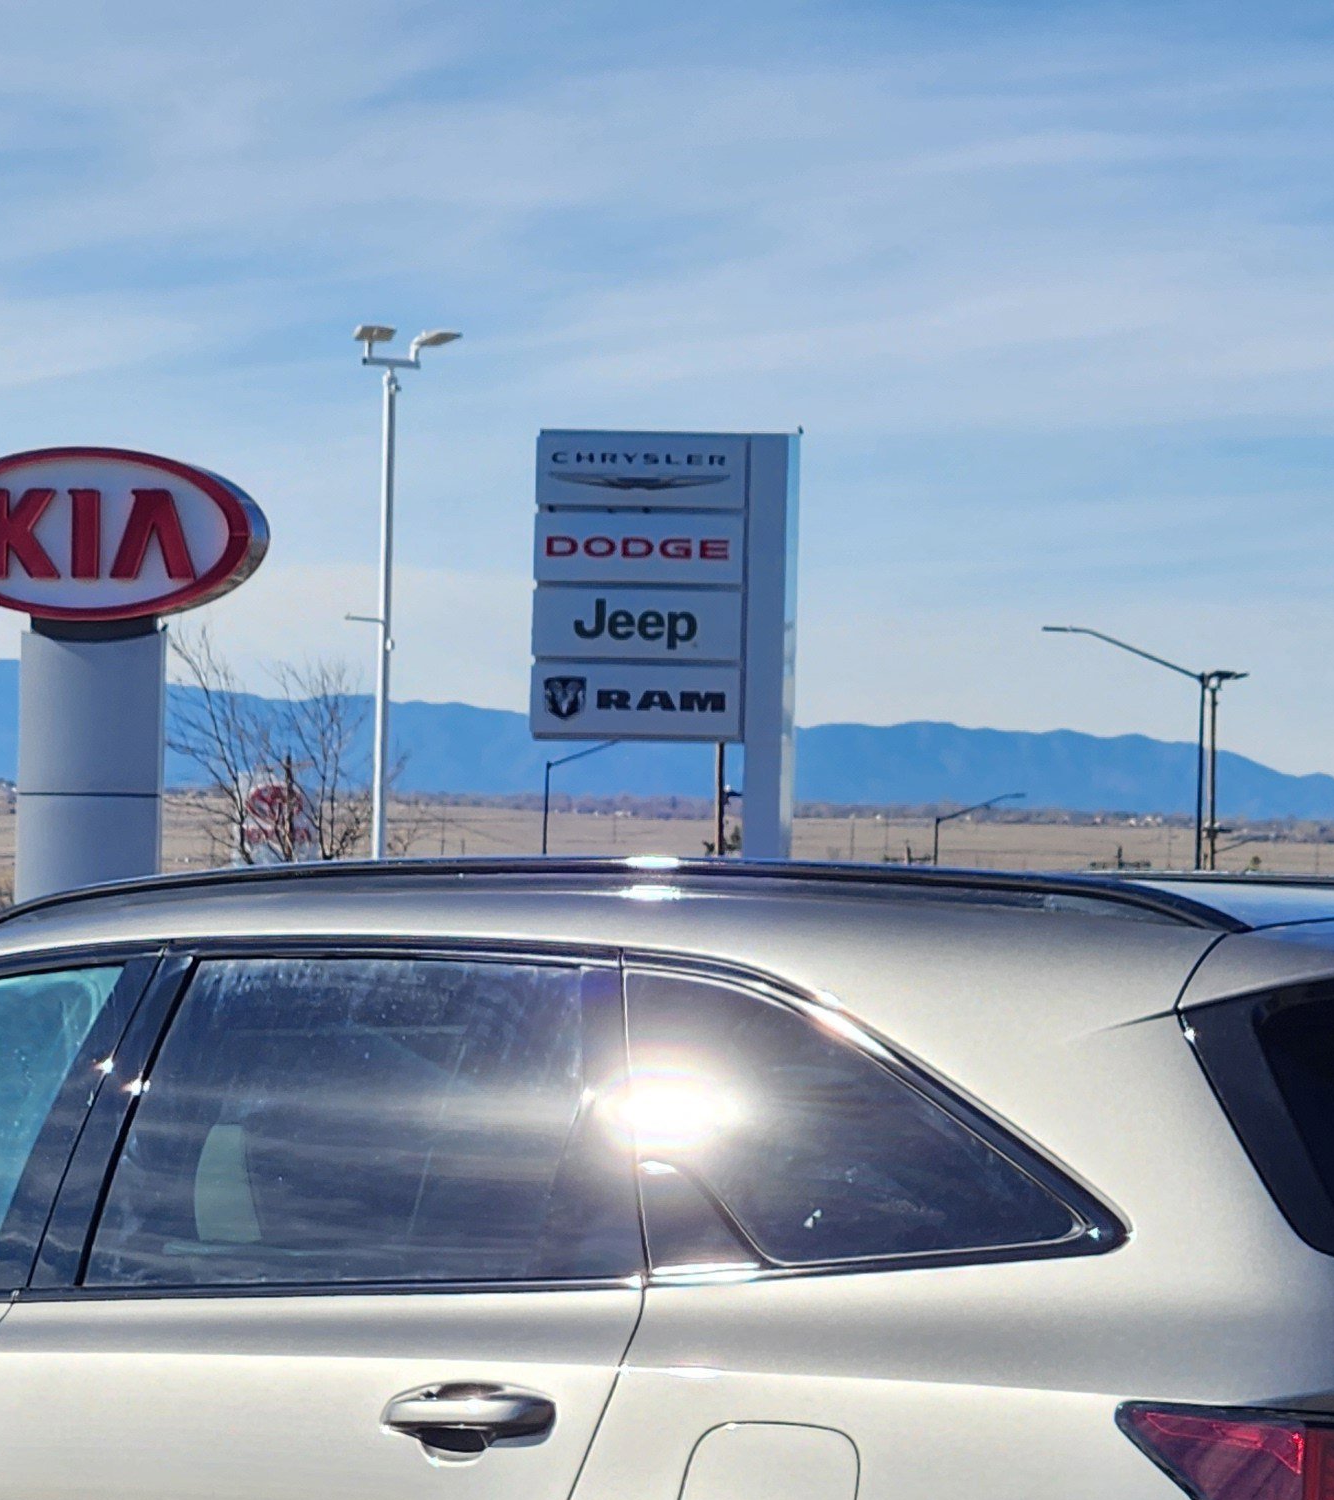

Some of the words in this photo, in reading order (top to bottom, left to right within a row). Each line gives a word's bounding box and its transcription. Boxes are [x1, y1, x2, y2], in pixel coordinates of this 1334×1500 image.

[551, 451, 727, 467] CHRYSLER
[545, 535, 730, 560] DODGE
[573, 598, 698, 650] Jeep
[596, 688, 726, 713] RAM
